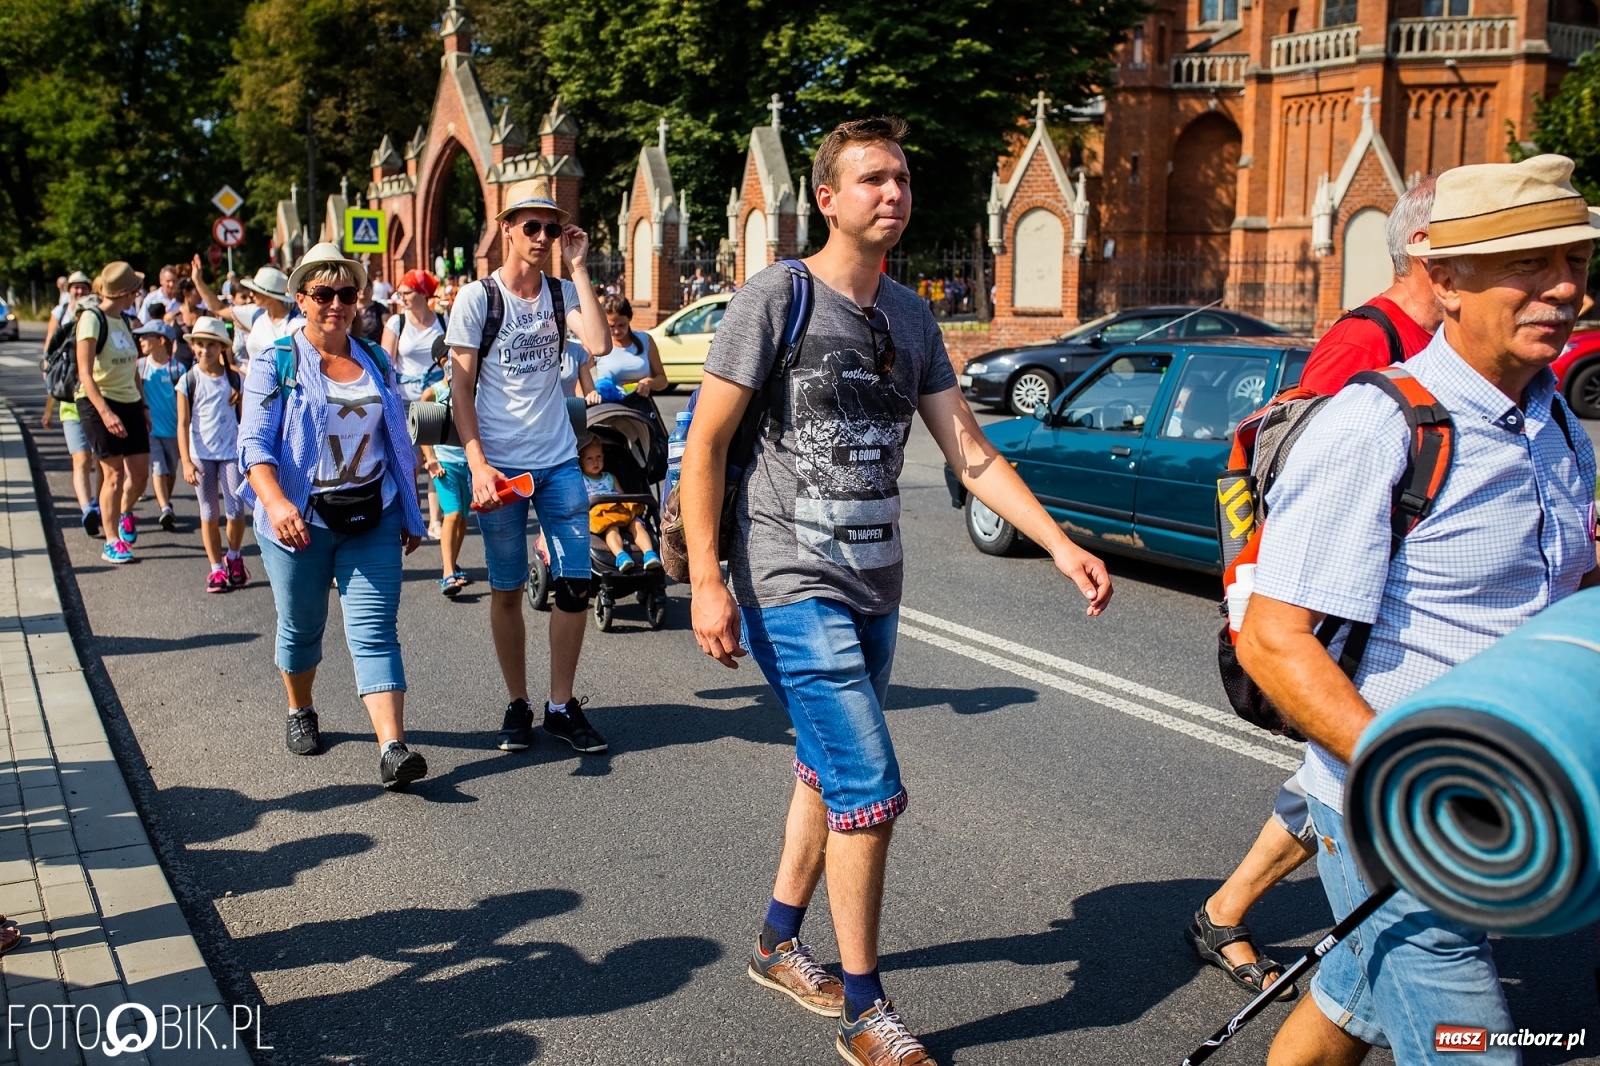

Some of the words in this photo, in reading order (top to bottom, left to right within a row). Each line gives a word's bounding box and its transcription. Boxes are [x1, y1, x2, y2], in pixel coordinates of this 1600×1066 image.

[496, 313, 533, 342] ENDLESS
[512, 332, 559, 350] California
[498, 348, 511, 364] 19
[507, 363, 538, 376] Malibu
[842, 367, 881, 383] nothing
[849, 450, 858, 461] IS
[859, 449, 881, 461] GOING
[848, 529, 857, 540] TO
[858, 529, 883, 540] HAPPEN
